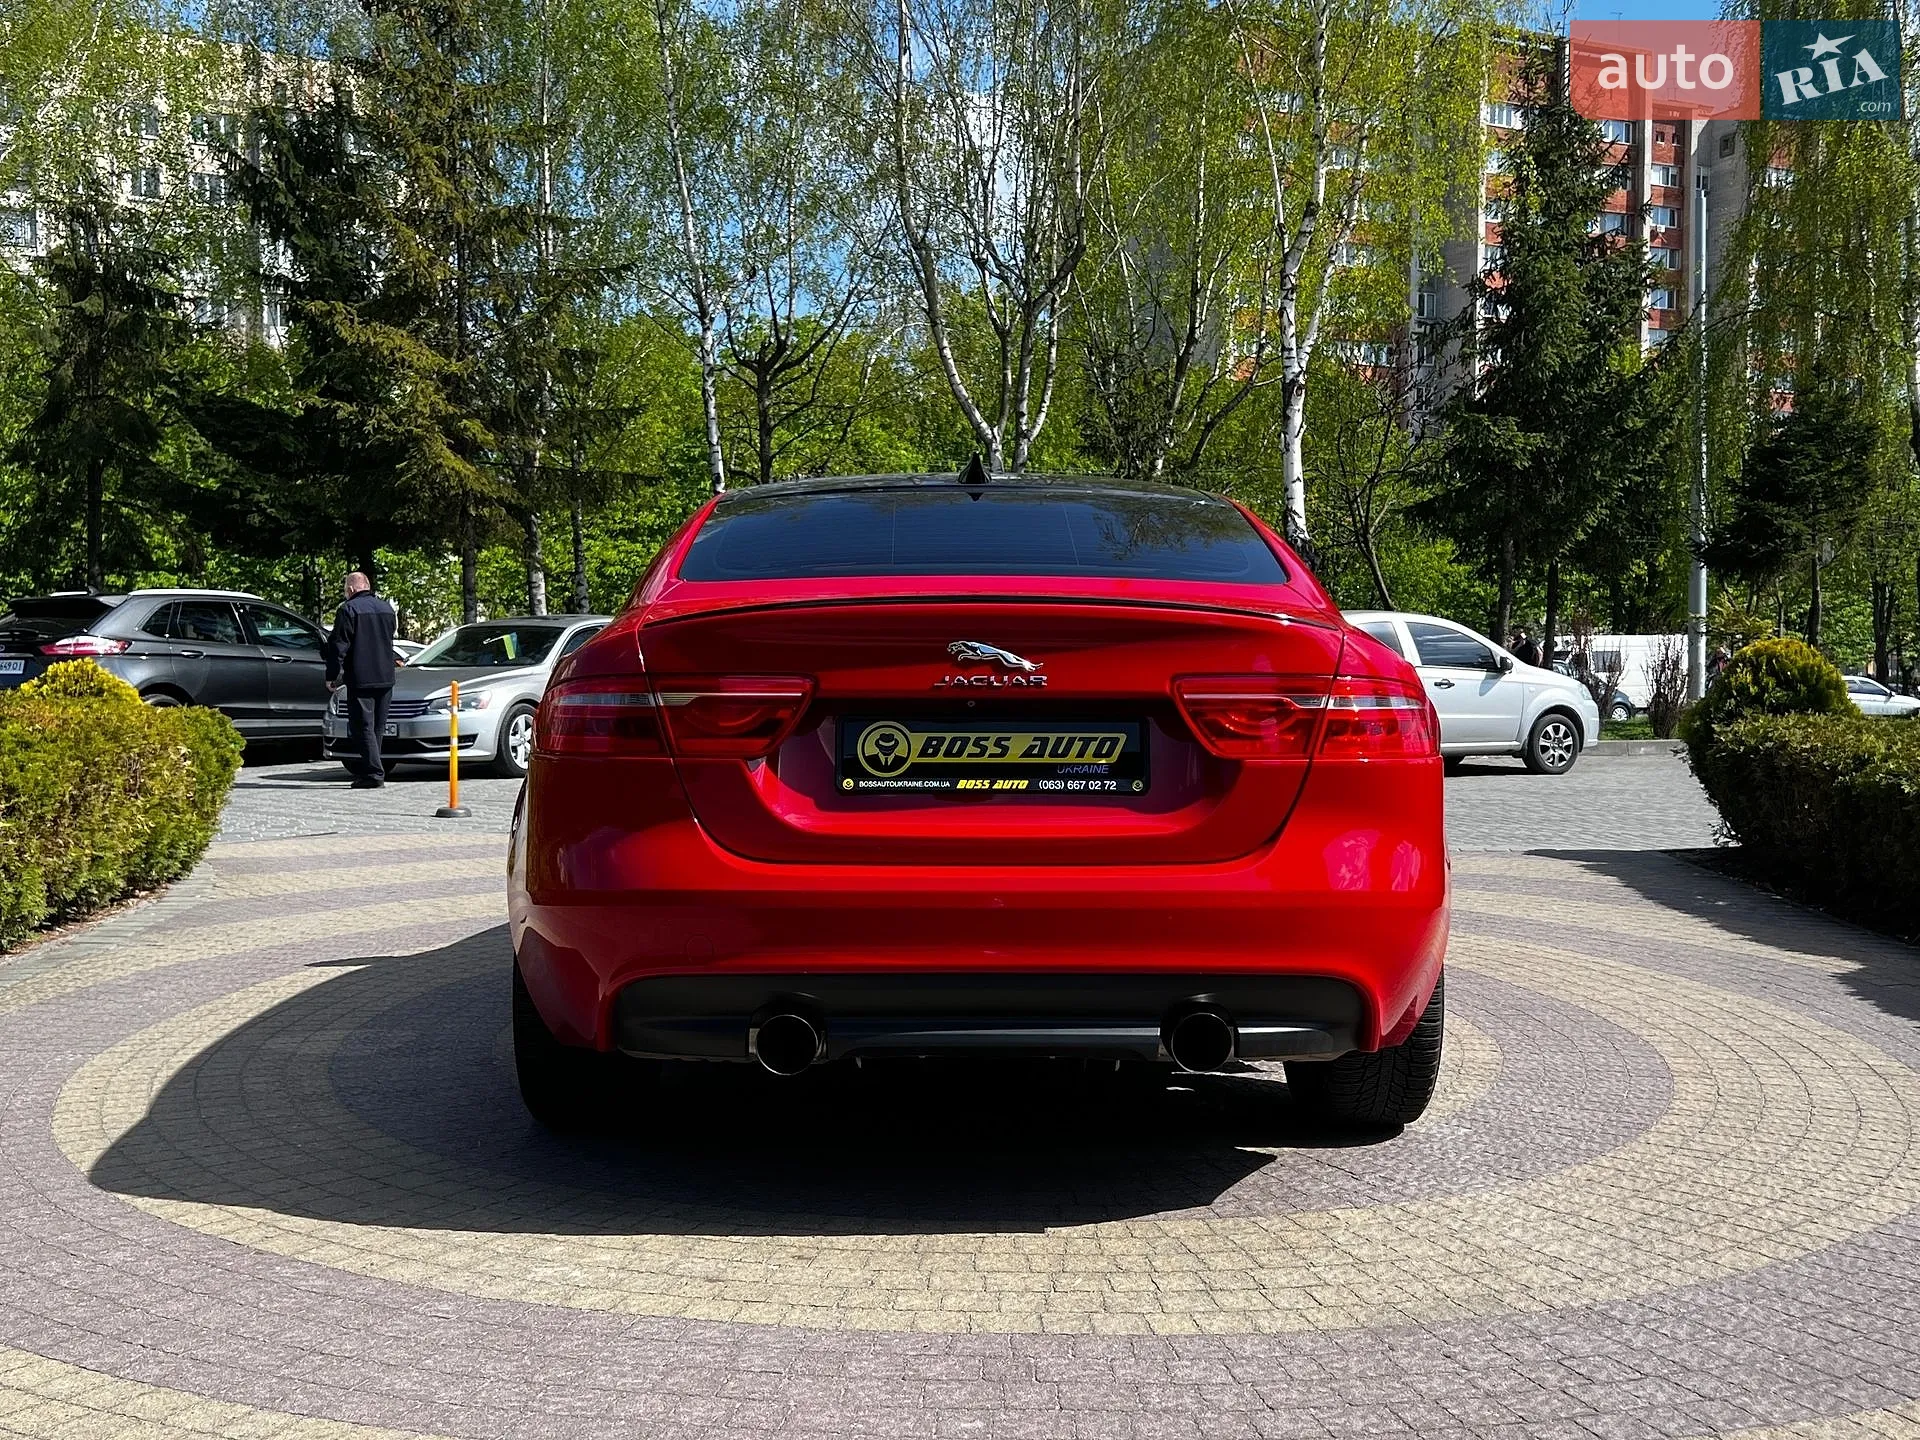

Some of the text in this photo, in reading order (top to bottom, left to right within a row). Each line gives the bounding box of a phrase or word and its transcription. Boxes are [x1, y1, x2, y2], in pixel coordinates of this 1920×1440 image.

[934, 675, 1048, 687] JAGUAR
[916, 736, 1121, 759] BOSS AUTO
[1057, 764, 1110, 774] UKRAINE
[858, 780, 951, 788] BOSSAUTOUKRAINE.COM.UA
[956, 779, 1029, 790] BOSS AUTO
[1038, 780, 1117, 790] (063) 667 02 72
